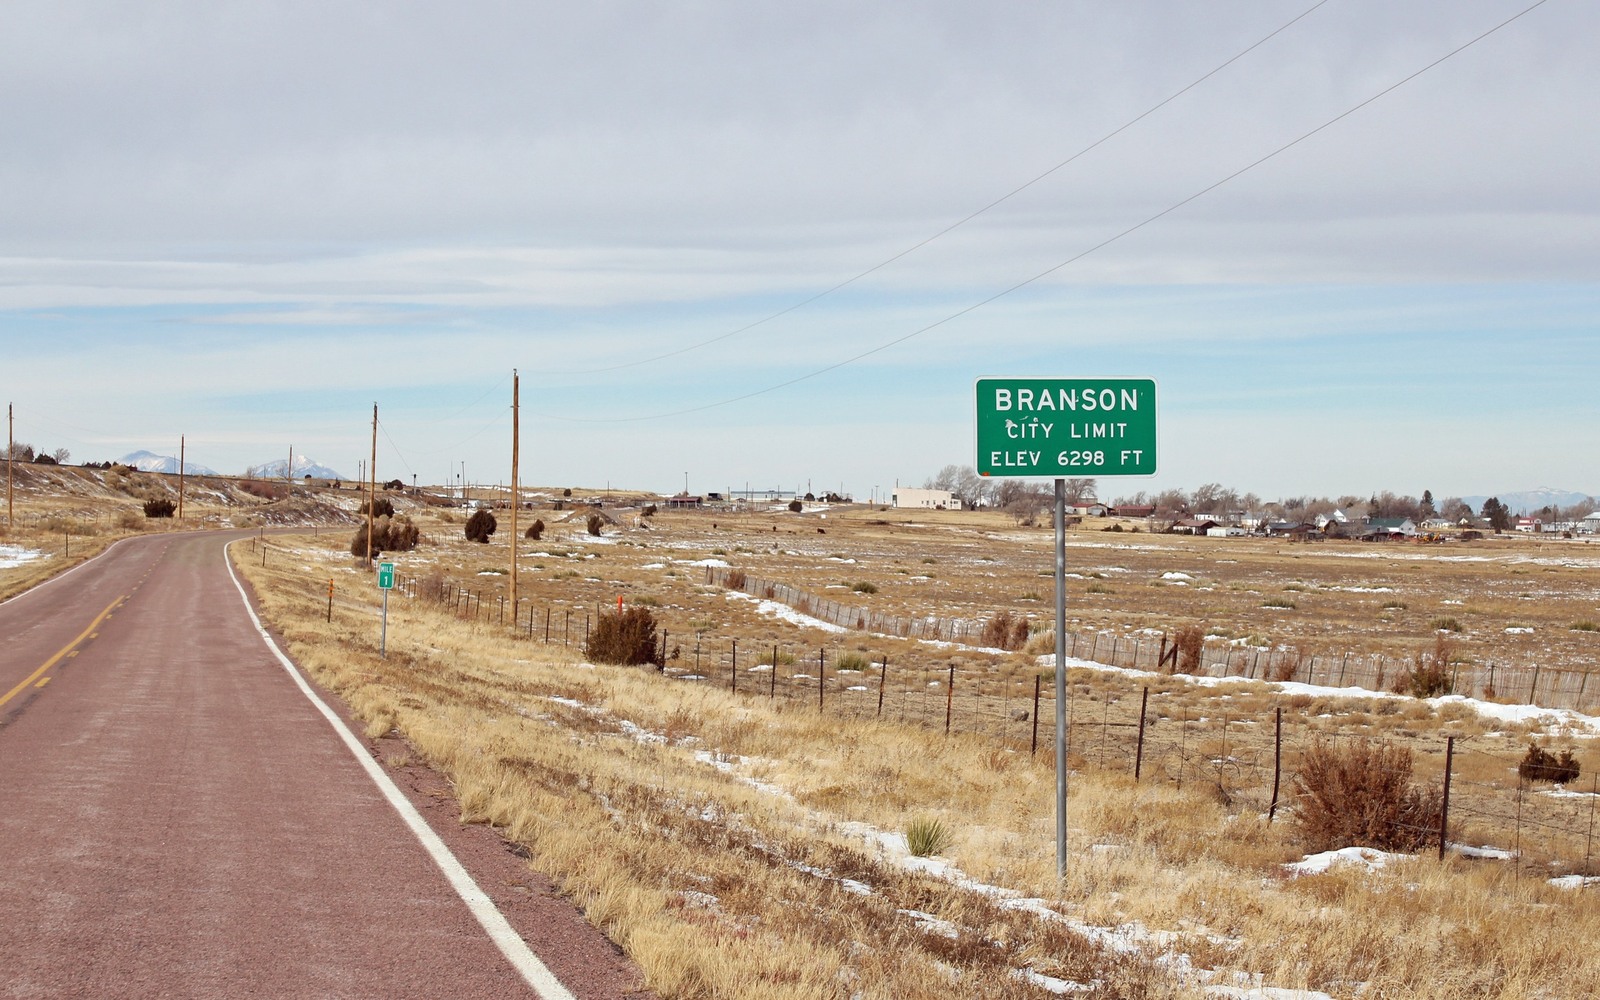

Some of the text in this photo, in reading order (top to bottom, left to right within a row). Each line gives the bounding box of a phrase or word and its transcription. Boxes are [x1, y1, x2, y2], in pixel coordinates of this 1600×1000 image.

[995, 388, 1137, 411] BRANSON
[1006, 423, 1127, 438] CITY LIMIT
[991, 450, 1143, 466] ELEV 6298 FT
[381, 565, 392, 573] MILE
[384, 576, 389, 586] 1
